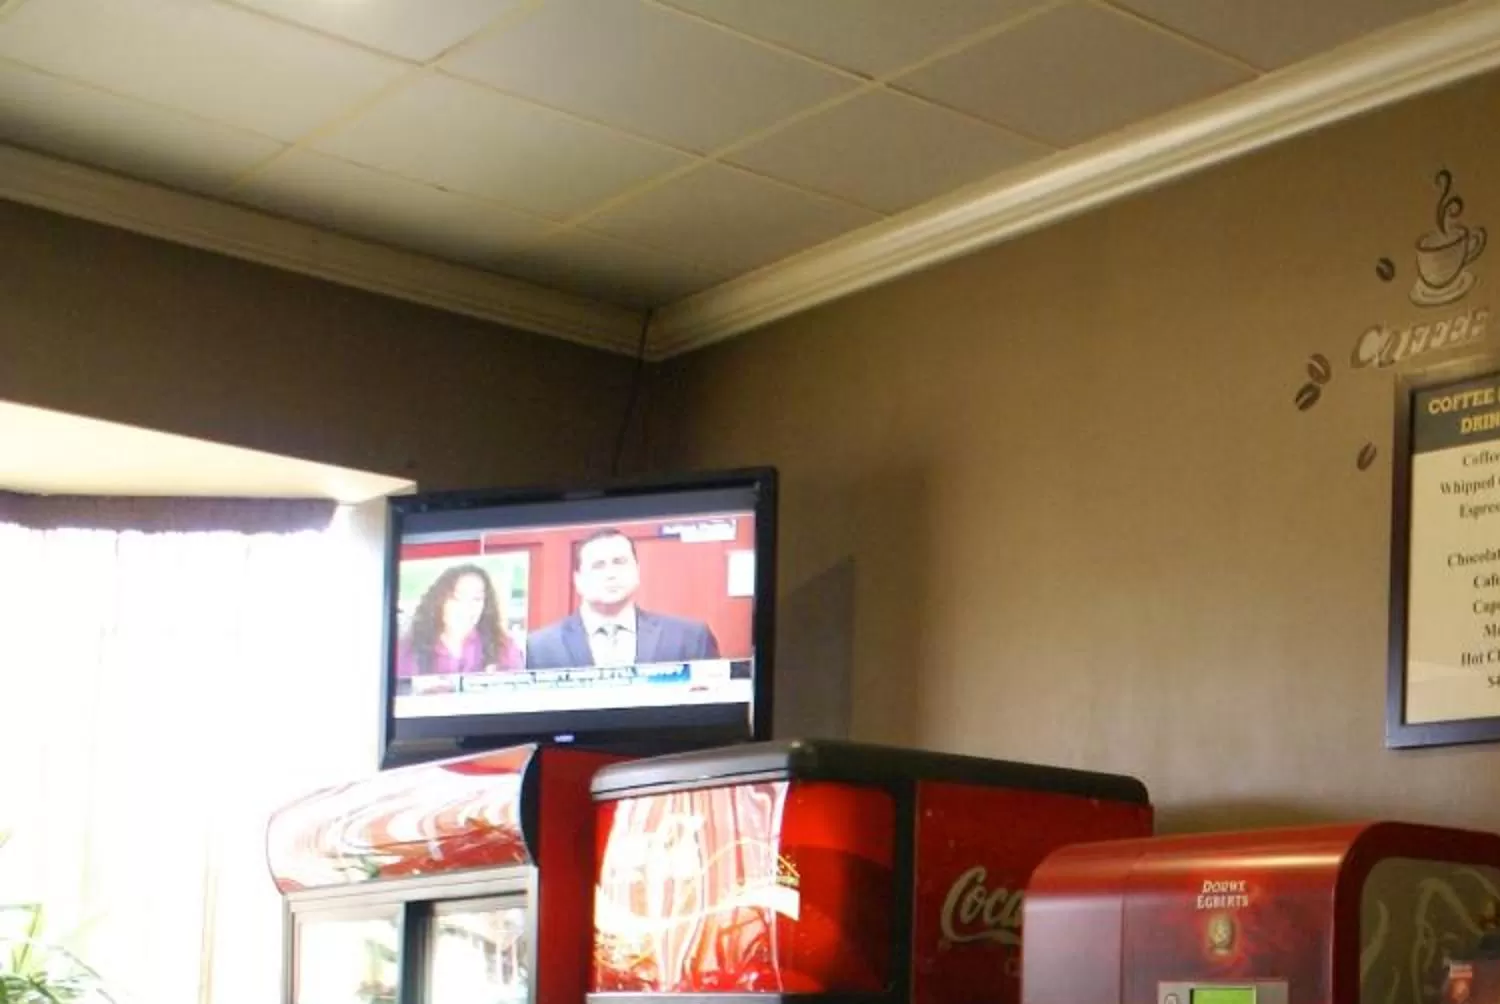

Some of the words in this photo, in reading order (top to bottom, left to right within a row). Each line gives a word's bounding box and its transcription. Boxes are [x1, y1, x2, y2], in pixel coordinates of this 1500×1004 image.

[1428, 387, 1494, 414] COFFEE
[1440, 474, 1496, 496] Whipped
[1460, 650, 1485, 667] Hot
